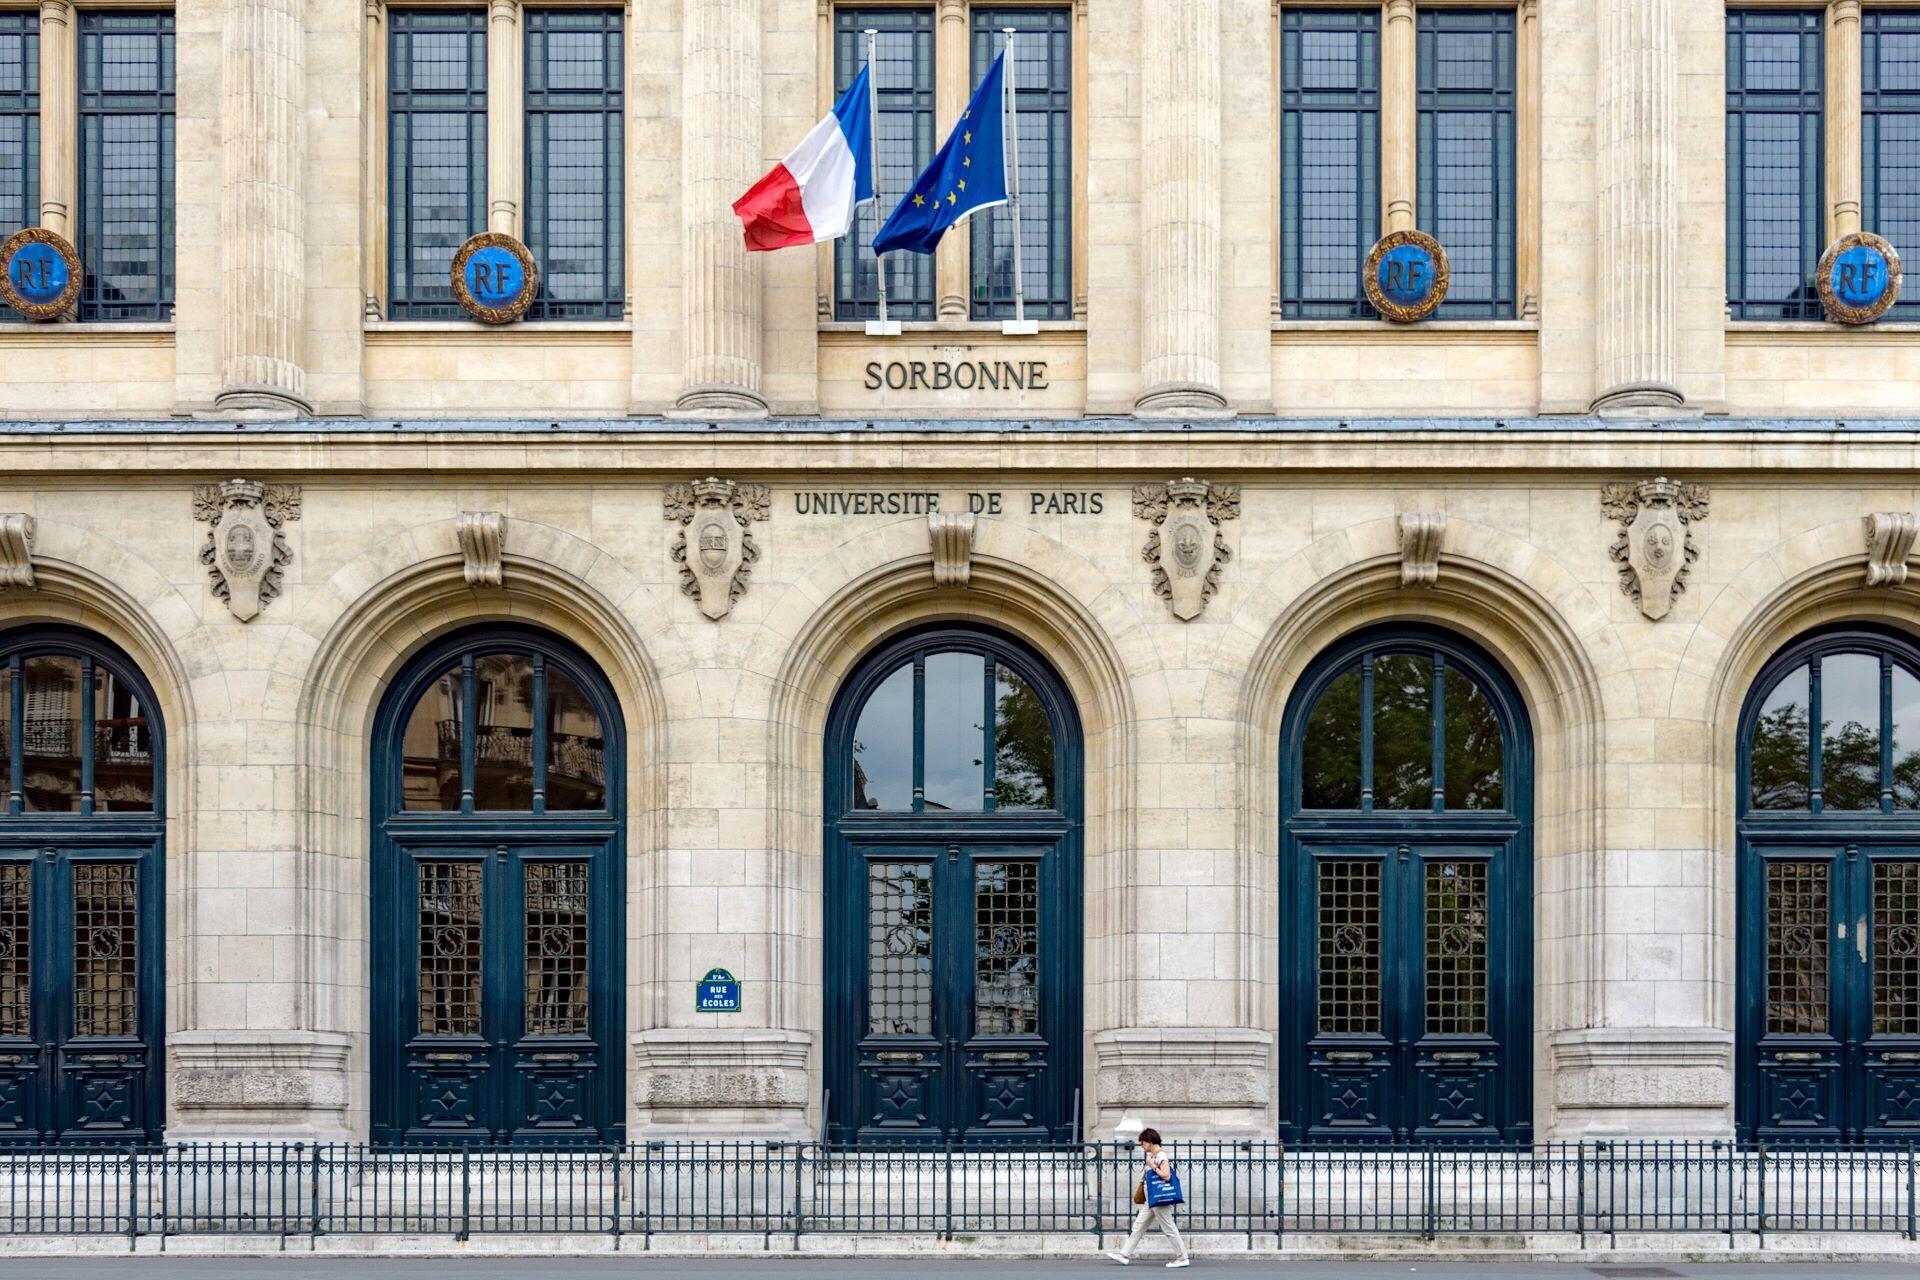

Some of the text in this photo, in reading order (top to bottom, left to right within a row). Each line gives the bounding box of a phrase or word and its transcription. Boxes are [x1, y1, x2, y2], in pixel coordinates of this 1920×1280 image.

[17, 259, 53, 291] RF
[474, 263, 511, 295] RF
[1387, 259, 1425, 292] RF
[1840, 263, 1878, 295] RF
[864, 361, 1050, 390] SORBONNE
[793, 492, 1104, 515] UNIVERSITE DE PARIS
[702, 998, 734, 1006] ÉCOLES
